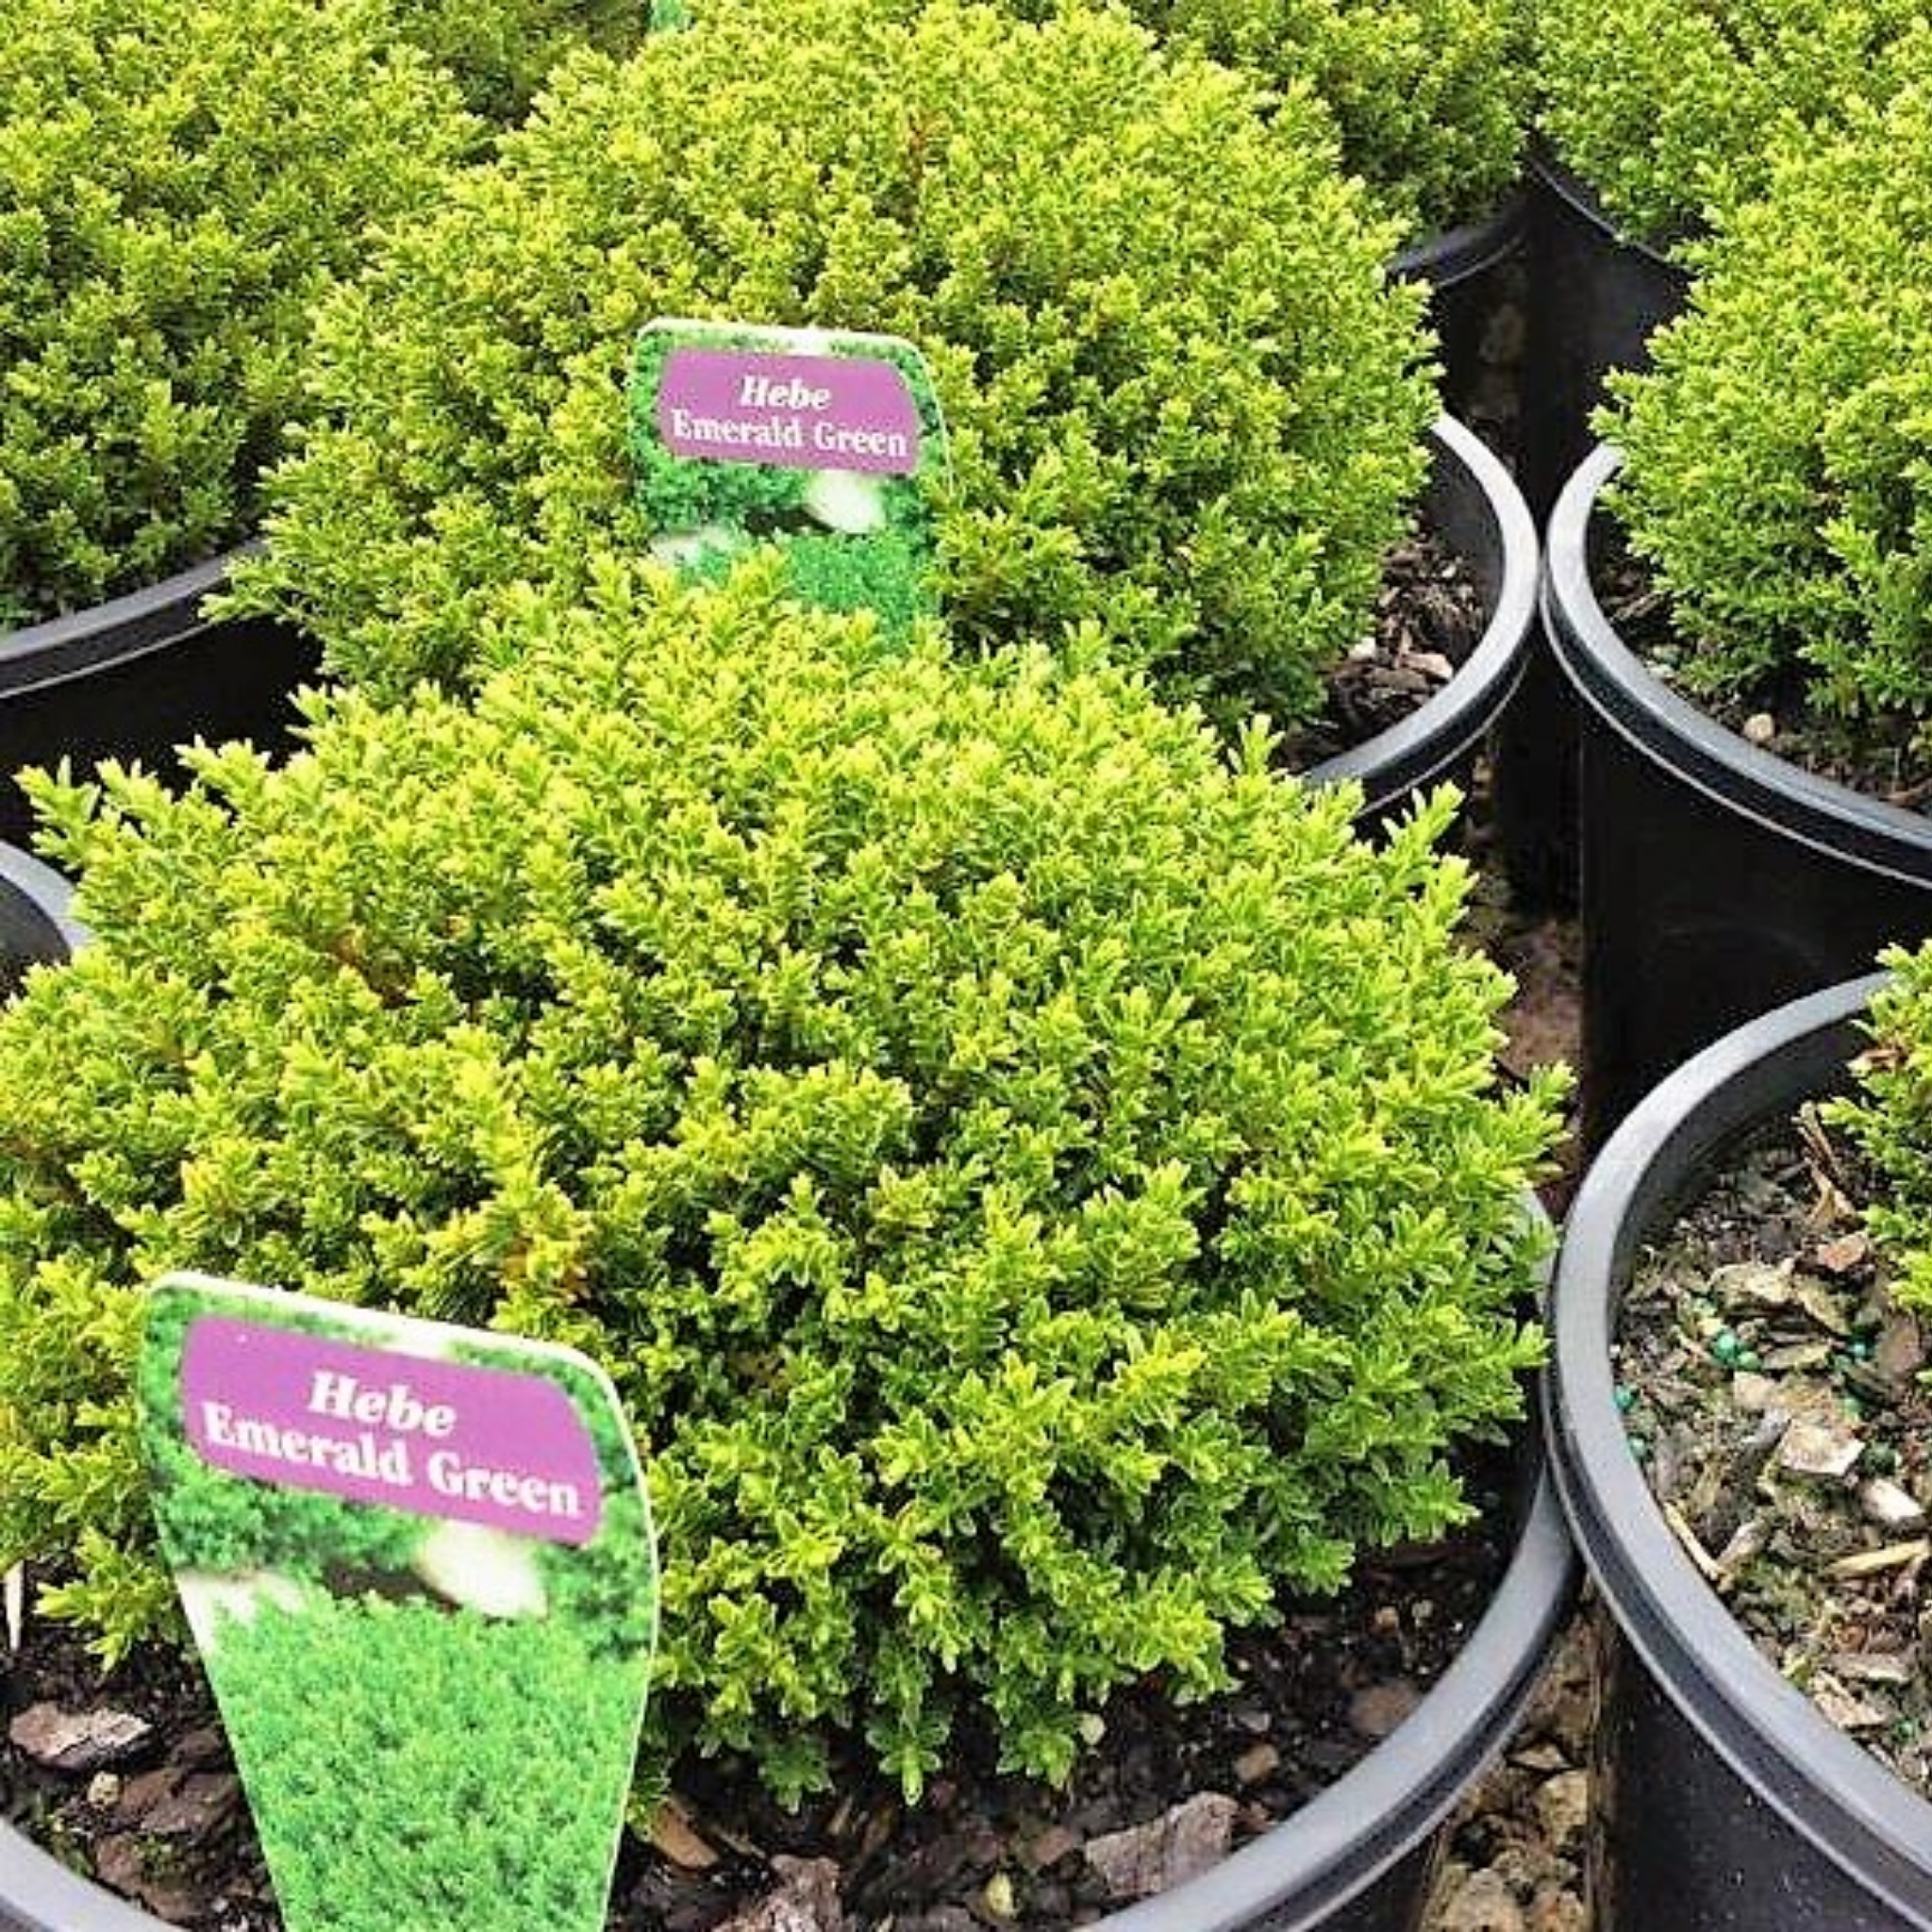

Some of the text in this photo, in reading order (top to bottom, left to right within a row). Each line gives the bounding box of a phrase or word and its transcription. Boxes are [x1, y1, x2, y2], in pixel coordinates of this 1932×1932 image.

[740, 375, 832, 410] Hebe
[671, 408, 908, 458] Emerald Green
[308, 1370, 458, 1437] Hebe
[202, 1402, 582, 1518] Emerald Green
